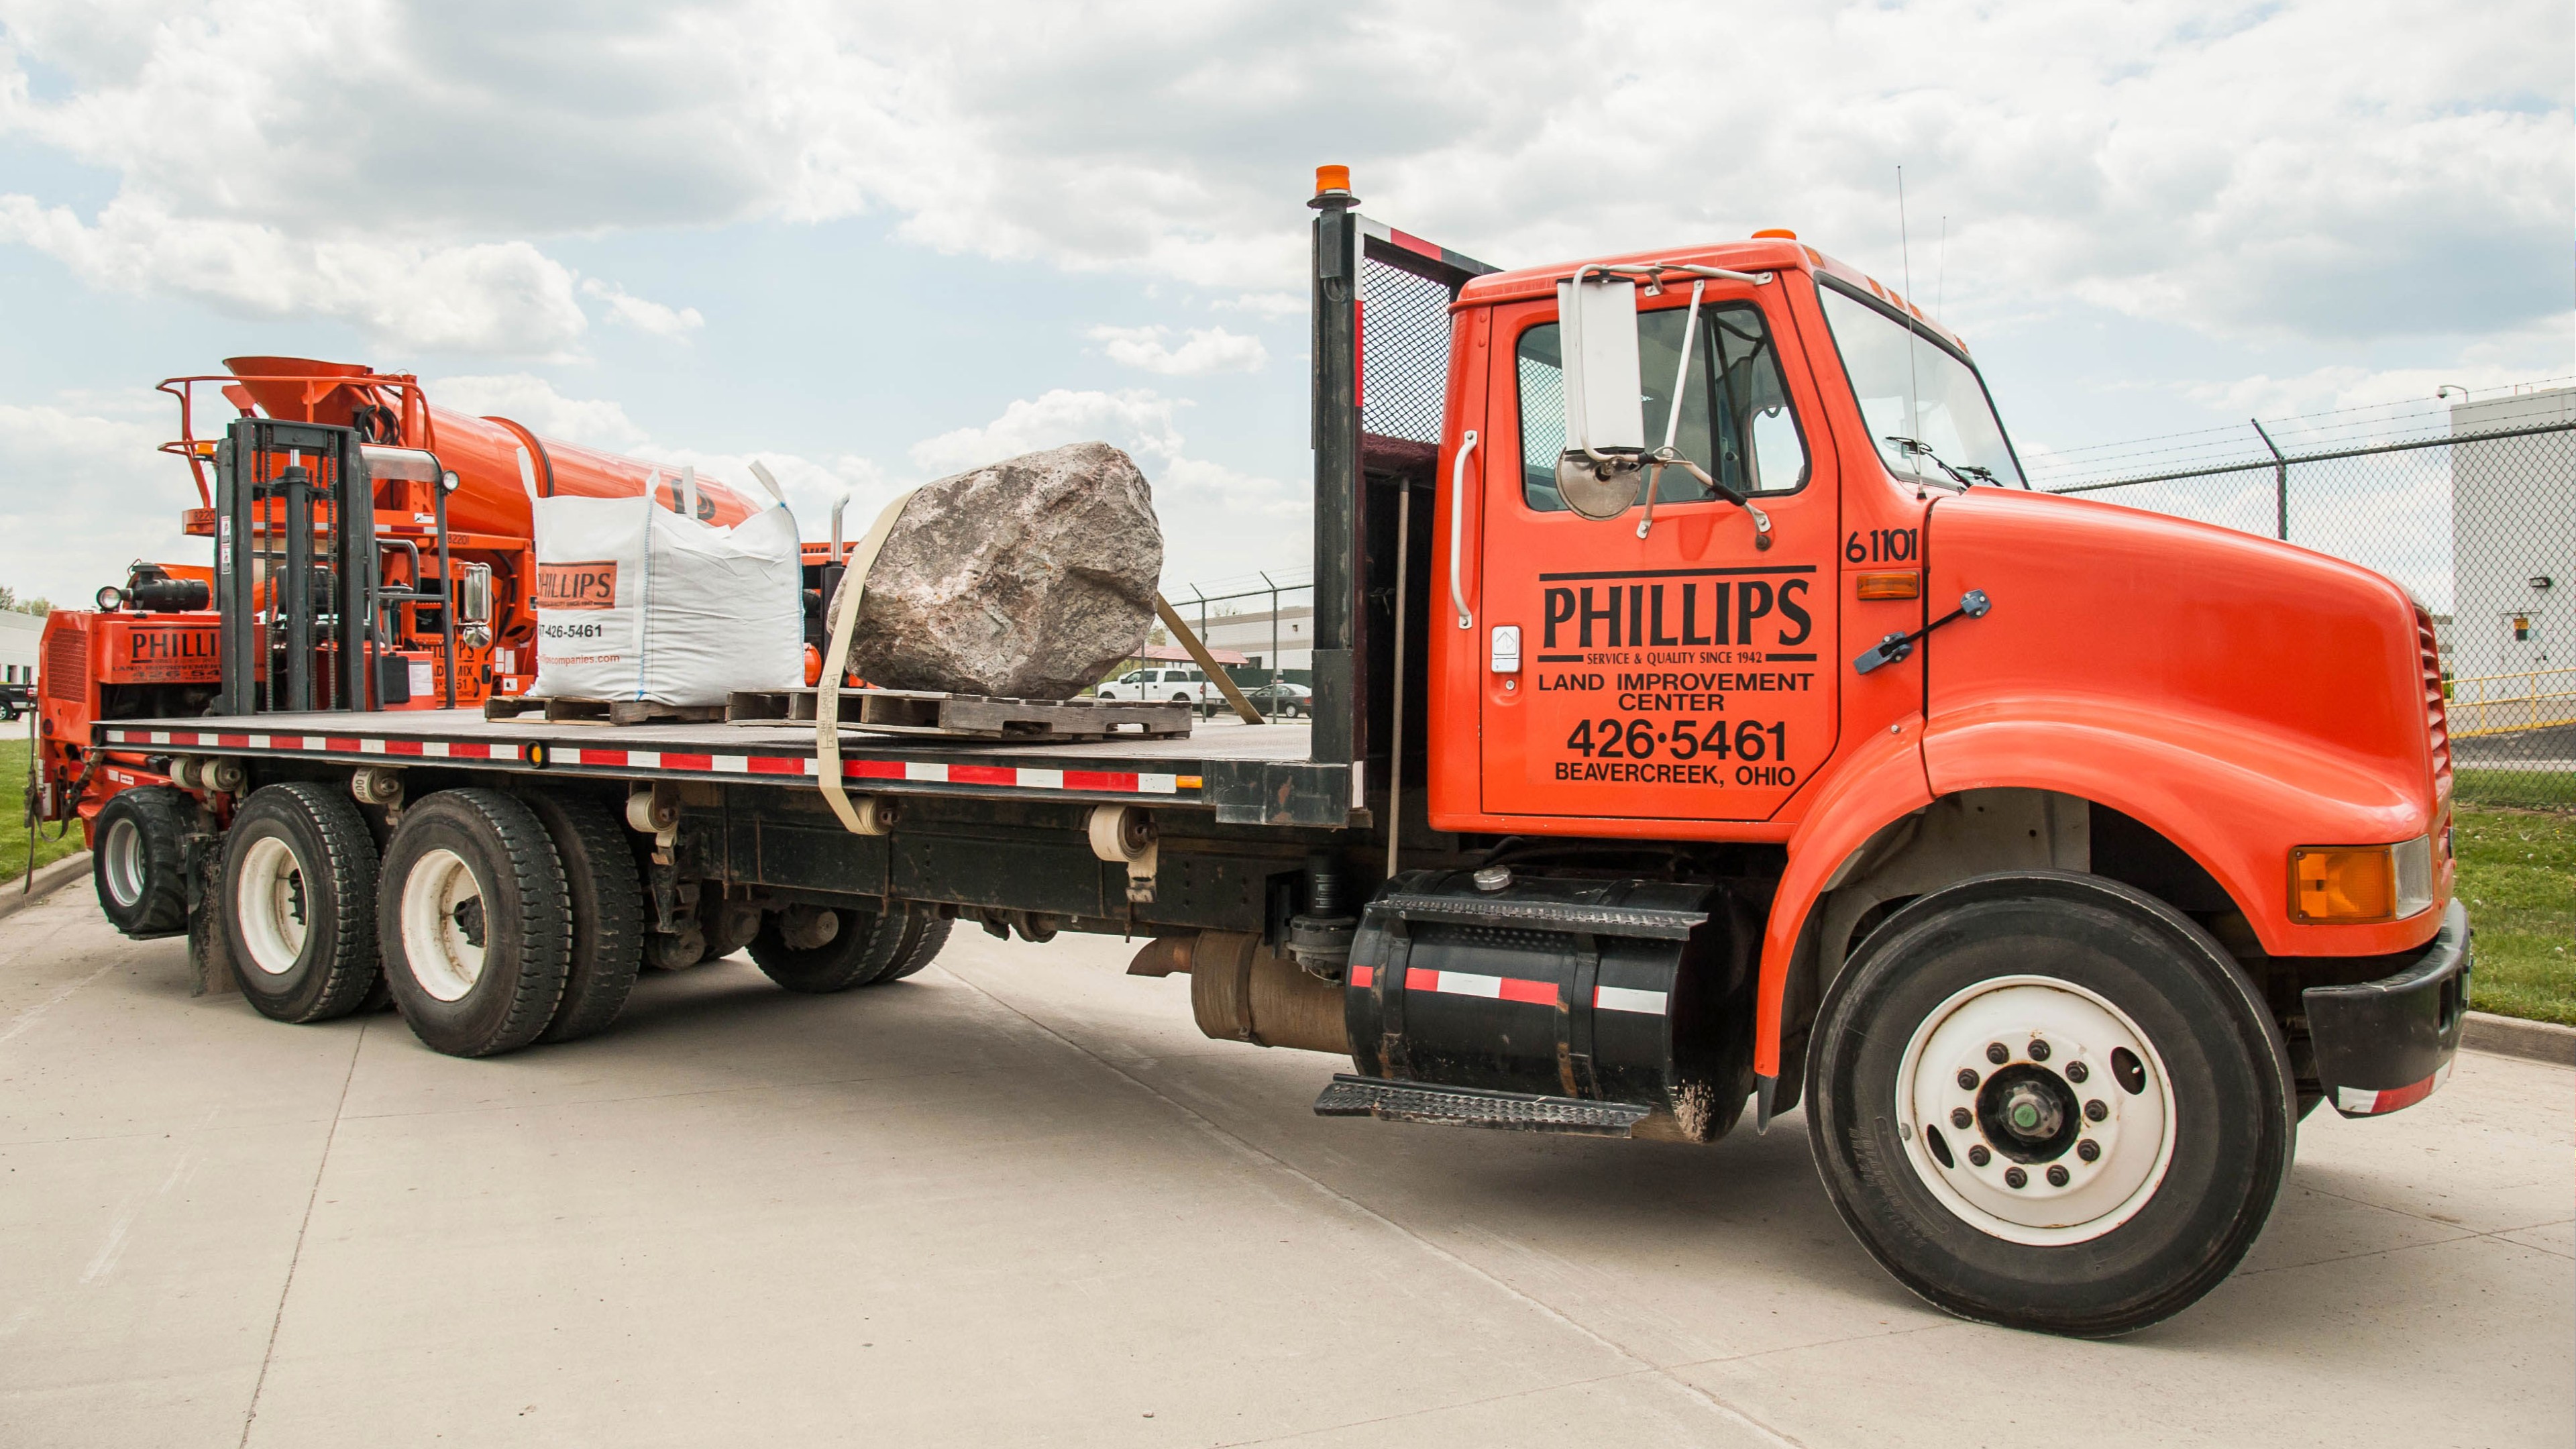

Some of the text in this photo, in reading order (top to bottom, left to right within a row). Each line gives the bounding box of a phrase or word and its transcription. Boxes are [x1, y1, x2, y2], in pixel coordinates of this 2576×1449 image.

[1845, 528, 1918, 564] 61101
[1544, 578, 1812, 649] PHILLIPS
[131, 633, 216, 658] PHILLI
[1587, 651, 1762, 666] SERVICE & QUALITY SINCE 1942
[1539, 673, 1815, 691] LAND IMPROVEMENT
[1618, 693, 1724, 711] CENTER
[1556, 762, 1796, 788] BEAVERCREEK, OHIO
